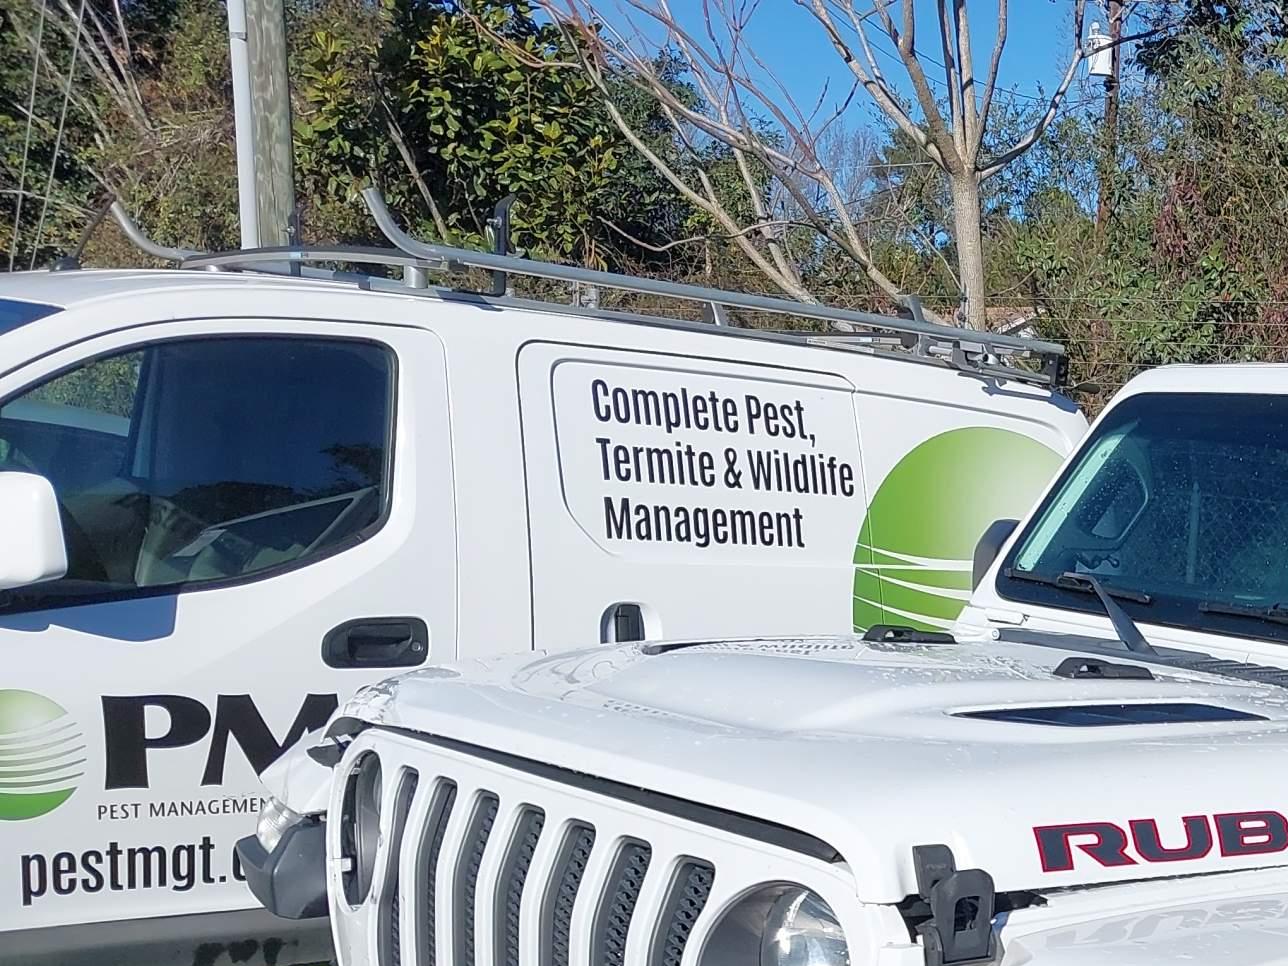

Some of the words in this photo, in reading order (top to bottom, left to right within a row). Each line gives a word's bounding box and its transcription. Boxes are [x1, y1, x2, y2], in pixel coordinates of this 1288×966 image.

[591, 378, 739, 434] Complete
[745, 394, 816, 447] Pest,
[595, 437, 716, 487] Termite
[723, 447, 743, 489] &
[747, 449, 855, 498] Wildlife
[603, 496, 805, 548] Management
[98, 803, 141, 820] PEST
